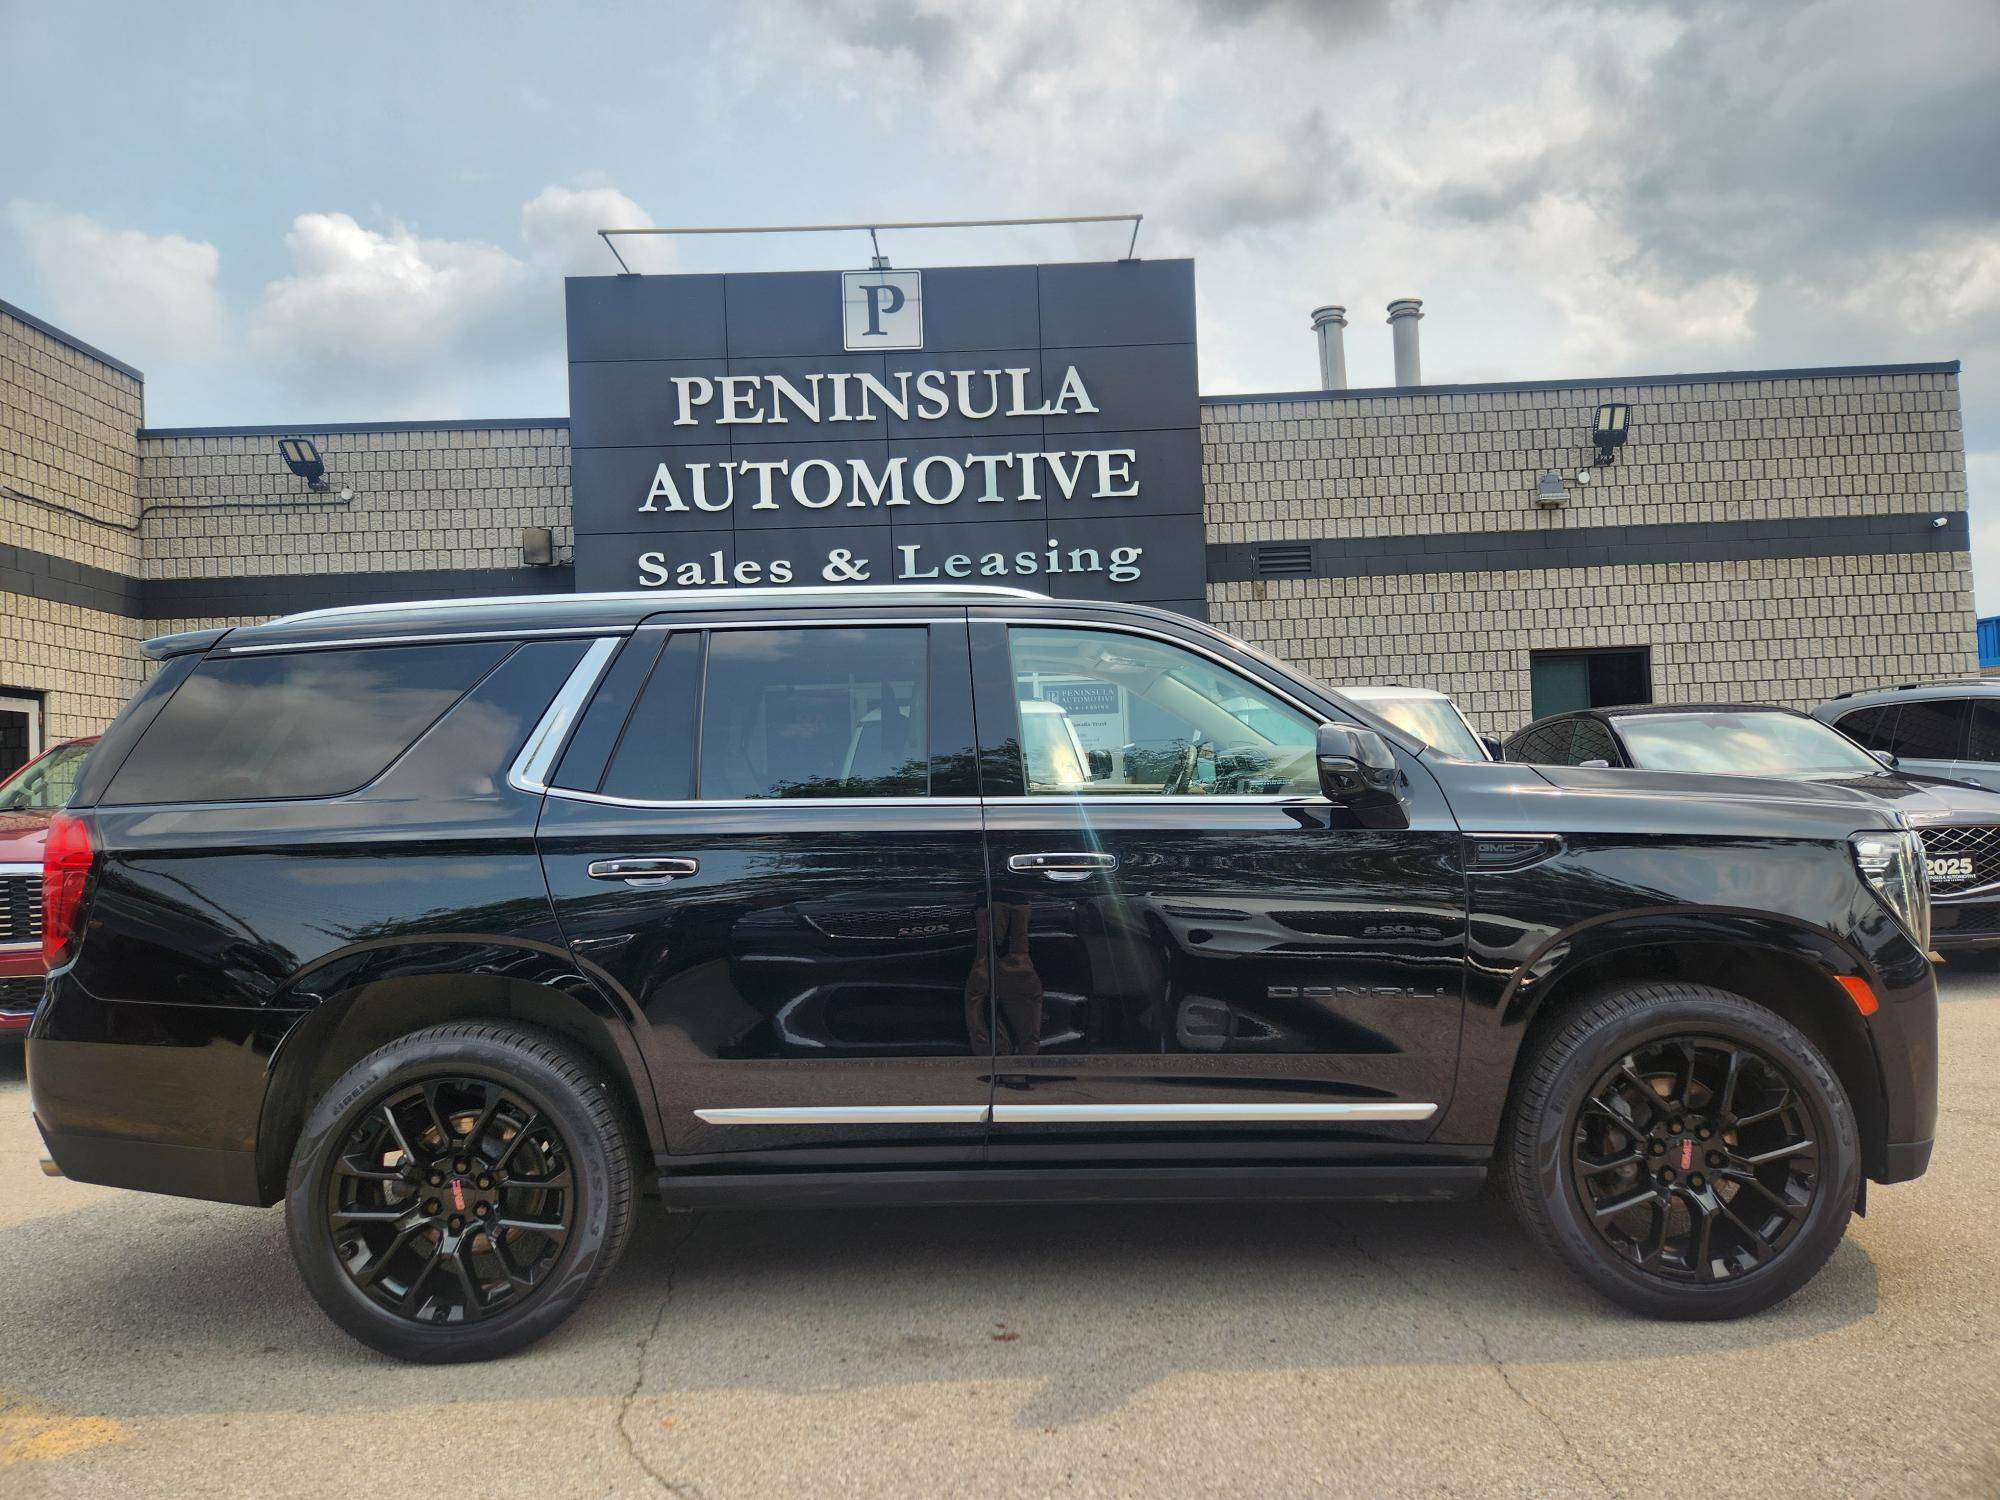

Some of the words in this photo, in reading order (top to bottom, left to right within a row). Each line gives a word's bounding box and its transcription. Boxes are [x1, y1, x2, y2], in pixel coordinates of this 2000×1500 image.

[858, 284, 905, 336] P
[671, 365, 1100, 426] PENINSULA
[638, 448, 1140, 512] AUTOMOTIVE
[638, 550, 793, 586] Sales
[822, 548, 870, 581] &
[897, 538, 1143, 582] Leasing
[1479, 843, 1516, 852] GMC
[1926, 857, 1973, 875] 2025
